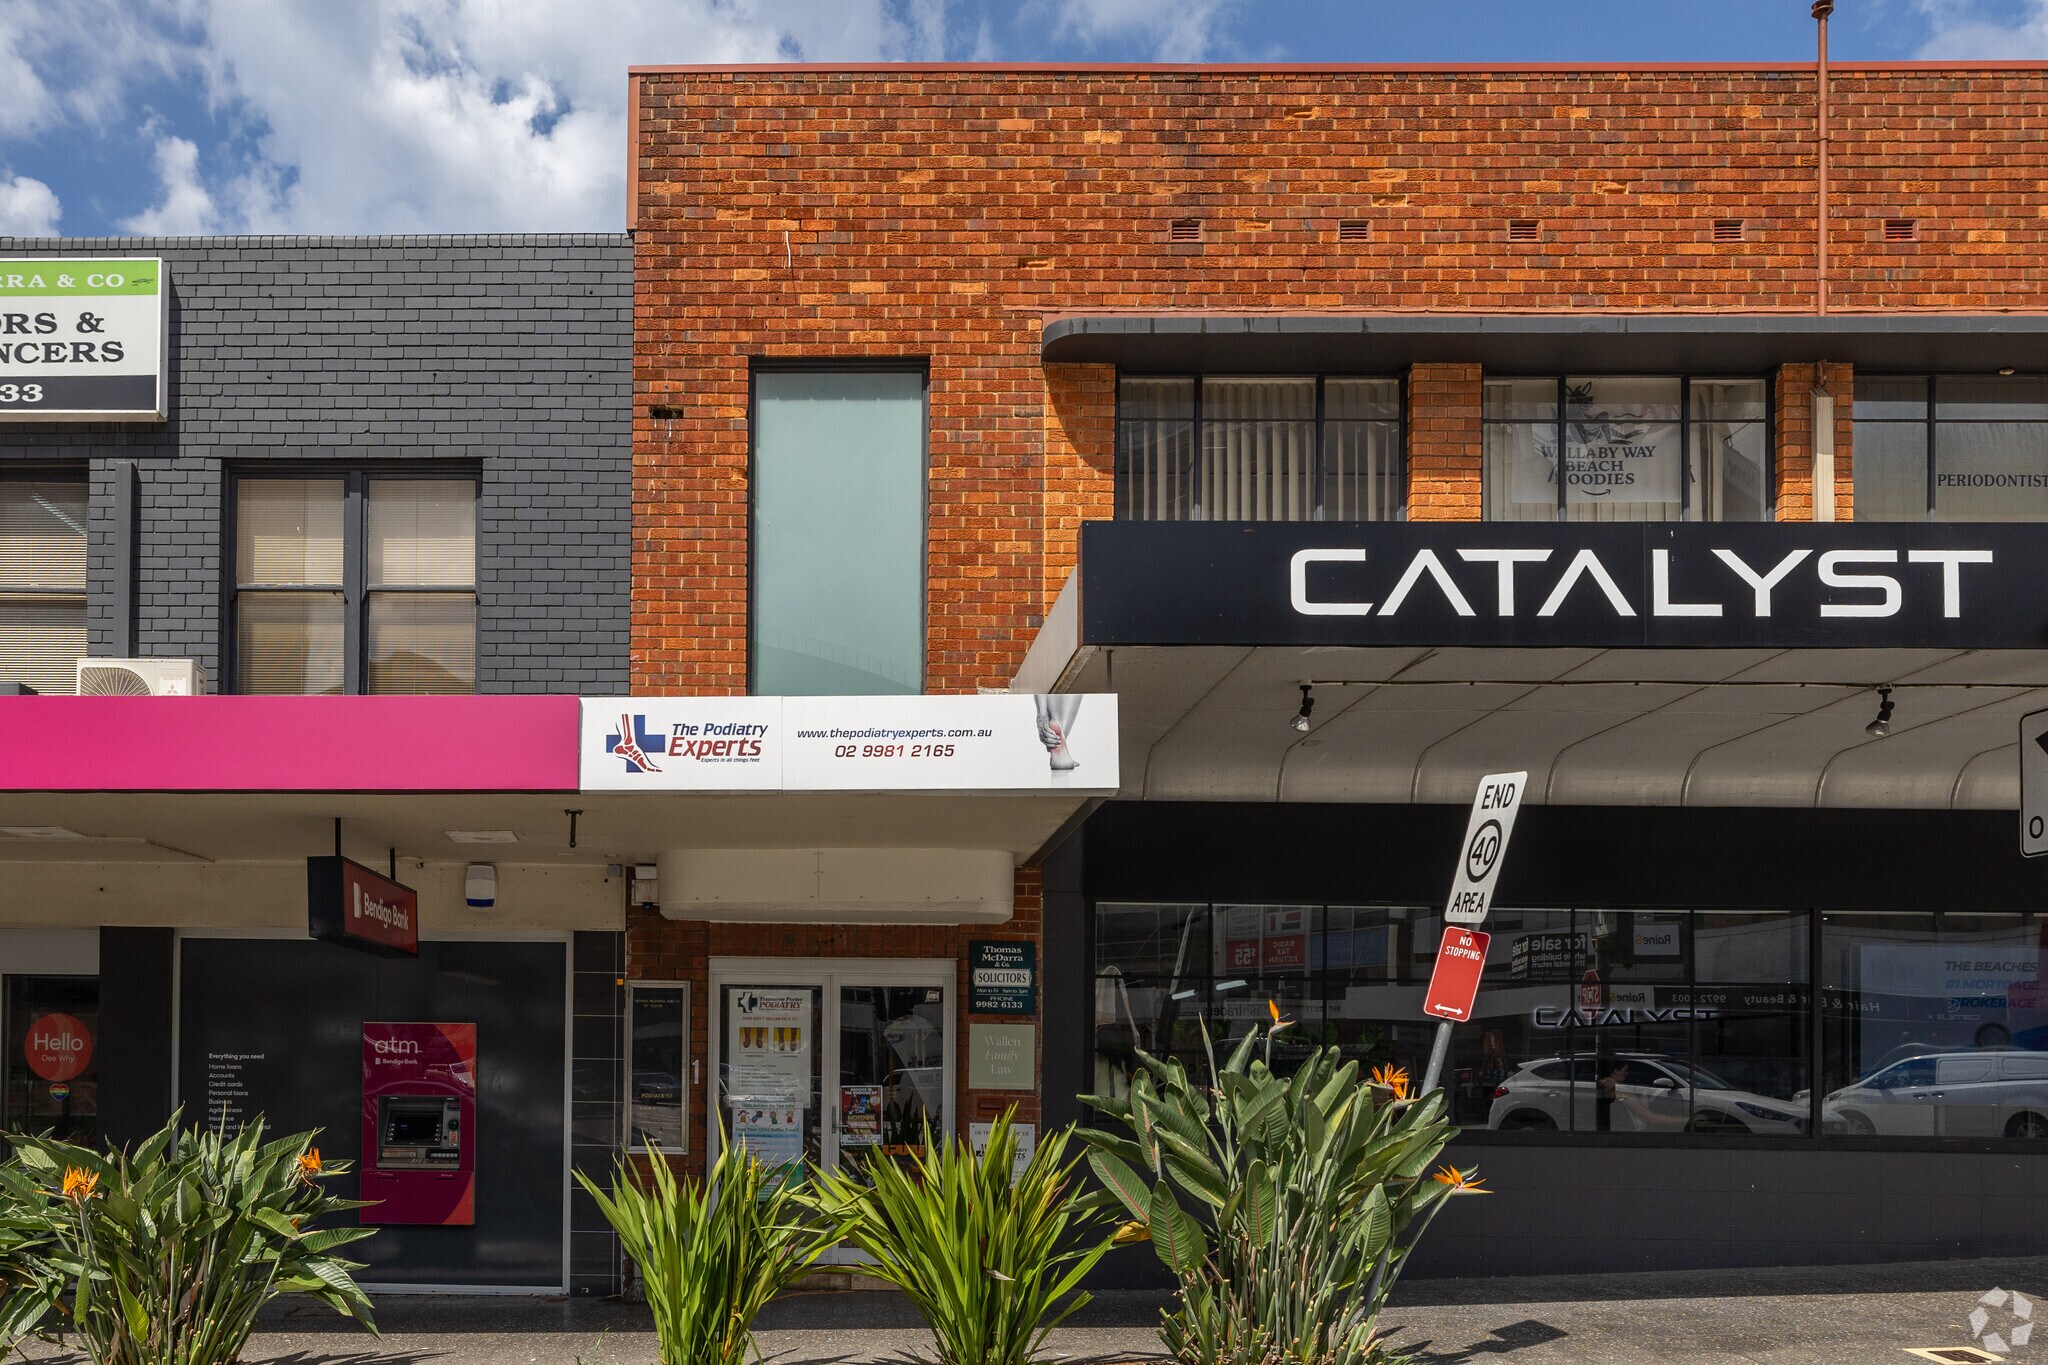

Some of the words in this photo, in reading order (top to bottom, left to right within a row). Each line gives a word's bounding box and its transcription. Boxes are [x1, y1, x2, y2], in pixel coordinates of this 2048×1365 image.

[57, 274, 76, 288] &
[87, 273, 125, 287] CO
[0, 312, 58, 334] RS
[76, 311, 105, 334] &
[1540, 445, 1618, 459] WLLABY
[1622, 445, 1656, 458] WAY
[1566, 460, 1624, 472] BEACH
[1290, 549, 1993, 618] CATALYST
[673, 723, 699, 736] The
[703, 723, 768, 738] Podiatry
[797, 728, 992, 741] www.thepodiatryexperts.com.au
[668, 737, 762, 760] Experts
[834, 745, 857, 758] 02
[862, 745, 904, 758] 9981
[911, 745, 955, 758] 2165
[1481, 783, 1515, 810] END
[1471, 836, 1497, 865] 40
[1451, 892, 1486, 914] AREA
[364, 892, 392, 929] Bendigo
[393, 904, 410, 931] Bank
[1459, 935, 1473, 947] NO
[983, 945, 1022, 953] Thomas
[1445, 946, 1480, 961] STOPPING
[1945, 961, 1971, 971] THE
[1974, 961, 2038, 972] BEACHES
[978, 973, 1027, 984] SOLICITORS
[1962, 980, 2041, 990] MORTGAGE
[34, 1033, 84, 1051] Hello
[375, 1036, 419, 1055] atm
[984, 1036, 1021, 1047] Wallen
[42, 1054, 57, 1062] Dee
[58, 1054, 75, 1063] Why
[985, 1051, 1020, 1063] Family
[991, 1064, 1013, 1075] Law
